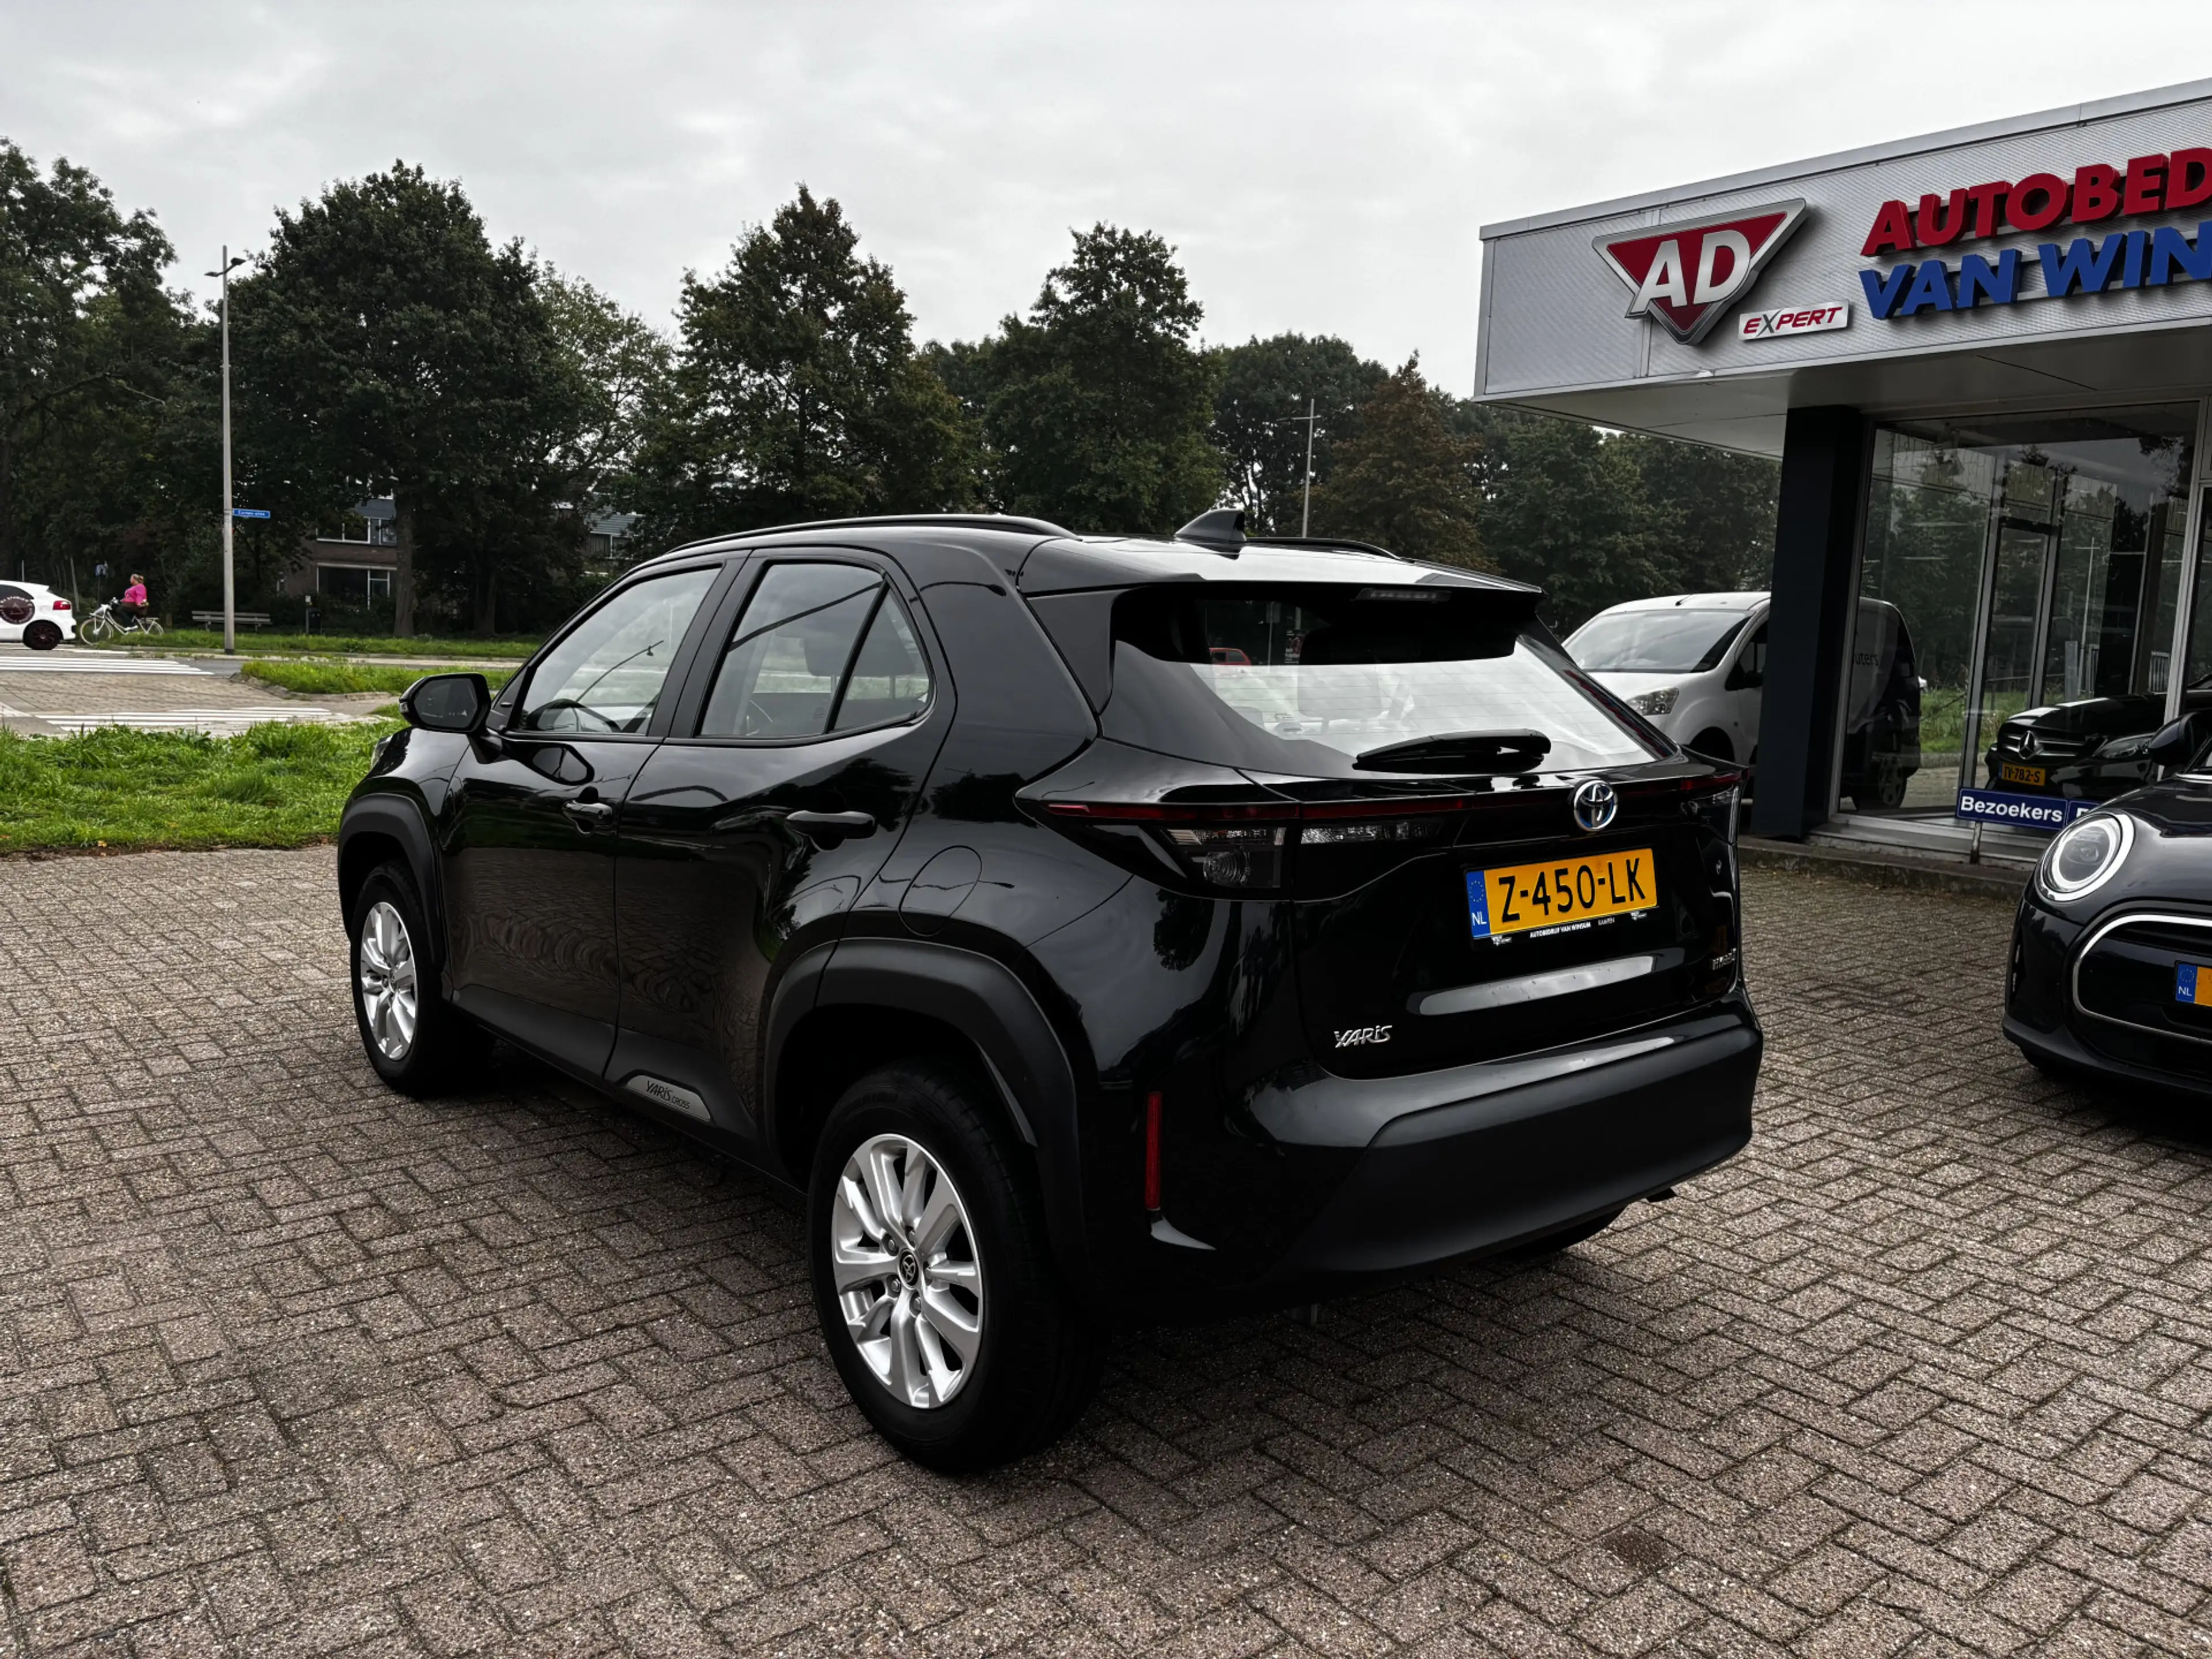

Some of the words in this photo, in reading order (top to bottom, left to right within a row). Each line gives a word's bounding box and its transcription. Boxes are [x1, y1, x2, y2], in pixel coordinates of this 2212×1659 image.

[1627, 229, 1751, 315] AD
[1858, 248, 2022, 320] VAN
[1743, 306, 1843, 337] EXPERT
[2004, 766, 2041, 783] TV-782-S
[1960, 796, 2063, 823] Bezoekers
[1498, 858, 1646, 923] Z-450-LK
[1471, 911, 1487, 926] NL
[2178, 986, 2193, 997] NL
